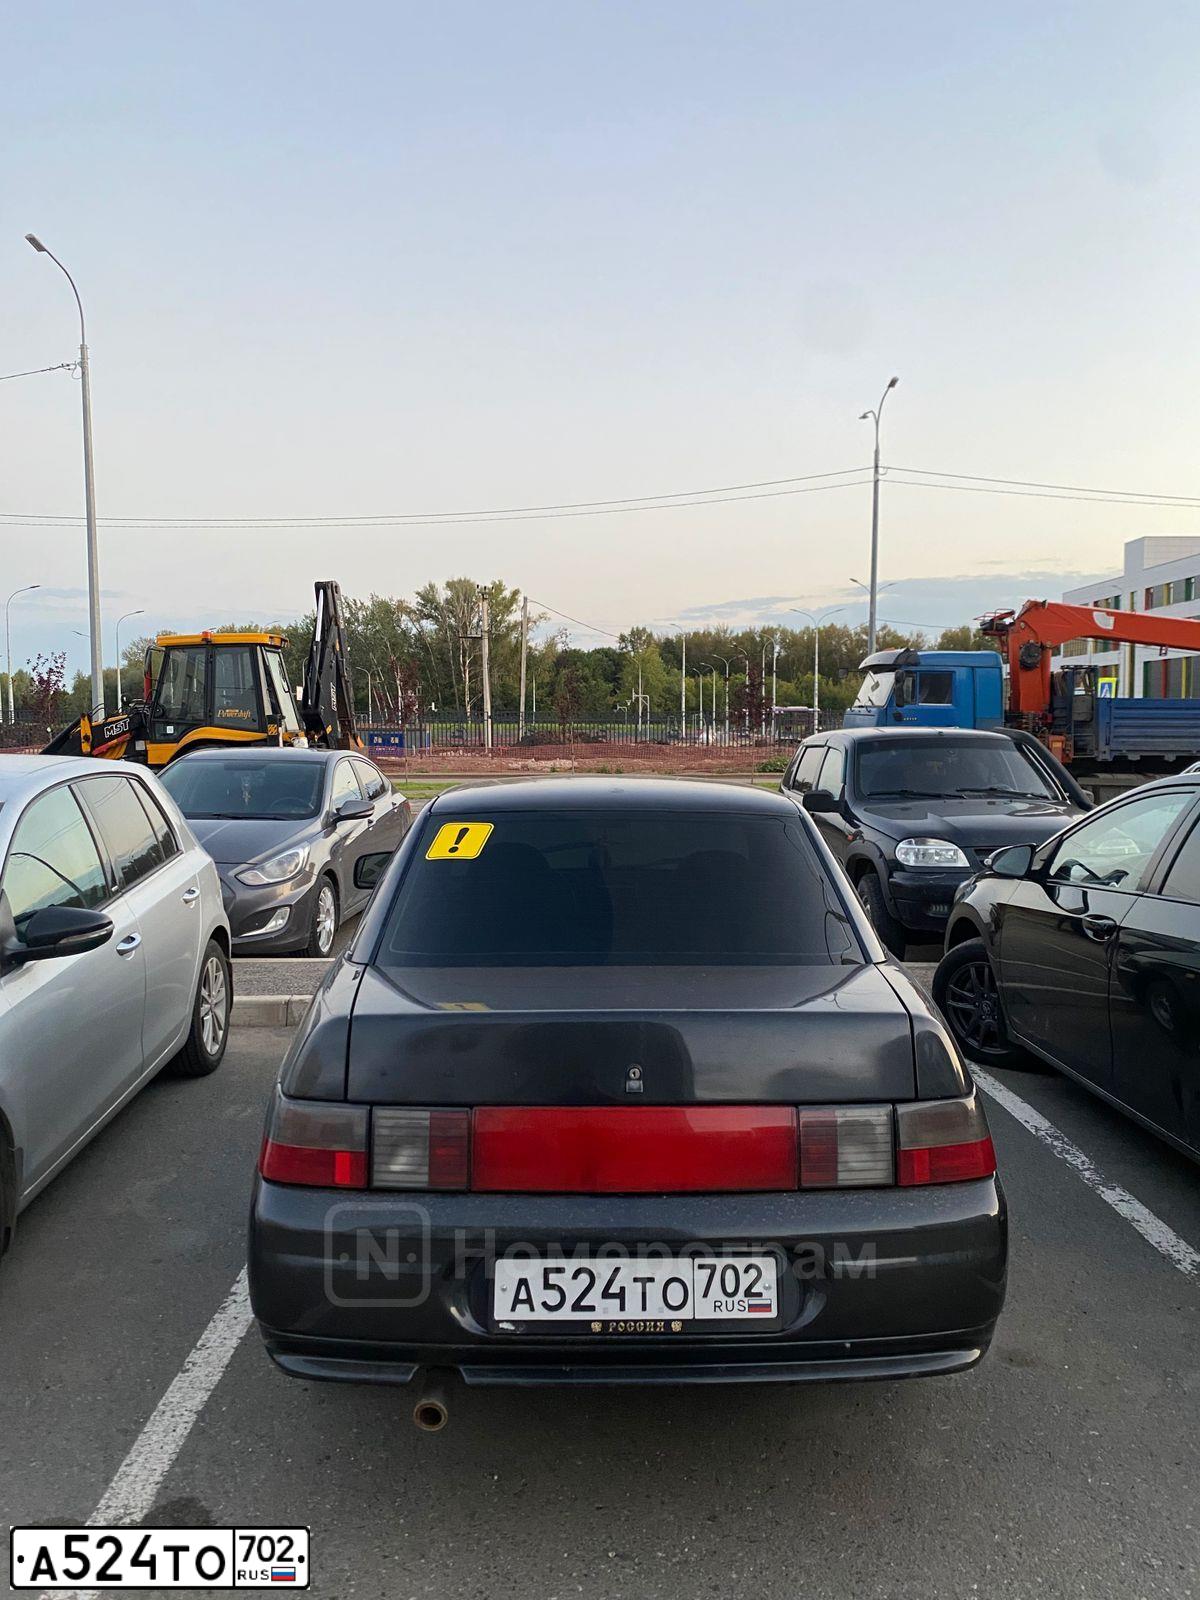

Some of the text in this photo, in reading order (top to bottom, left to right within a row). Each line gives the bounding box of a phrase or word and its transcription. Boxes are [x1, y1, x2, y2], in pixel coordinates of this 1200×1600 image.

[104, 718, 130, 738] MST
[697, 1263, 764, 1299] 702
[713, 1300, 747, 1313] RUS
[608, 1321, 664, 1333] РОССИЯ
